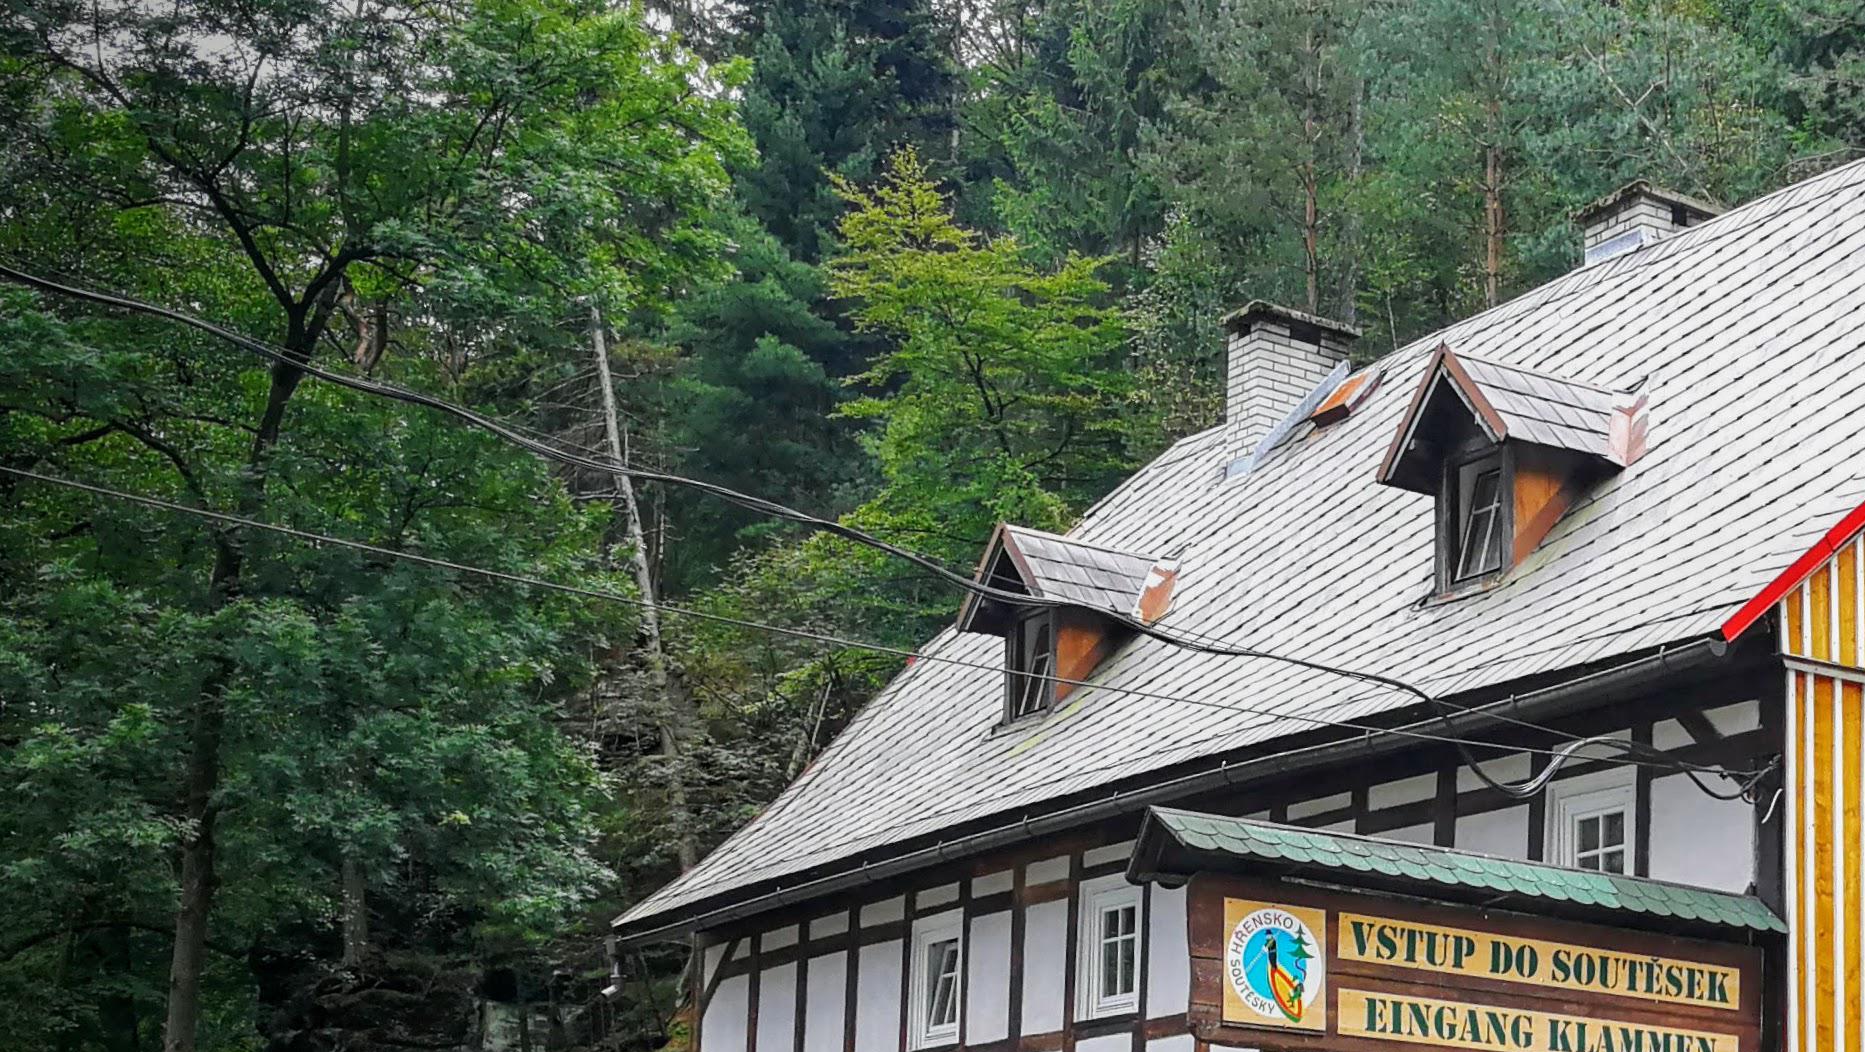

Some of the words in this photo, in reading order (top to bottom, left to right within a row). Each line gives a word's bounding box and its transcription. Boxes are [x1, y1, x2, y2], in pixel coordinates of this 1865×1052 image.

[1231, 912, 1293, 954] HŘENSKO
[1351, 921, 1475, 969] VSTUP
[1489, 942, 1537, 978] DO
[1551, 949, 1730, 1004] SOUTĚSEK
[1365, 997, 1533, 1049] EINGANG
